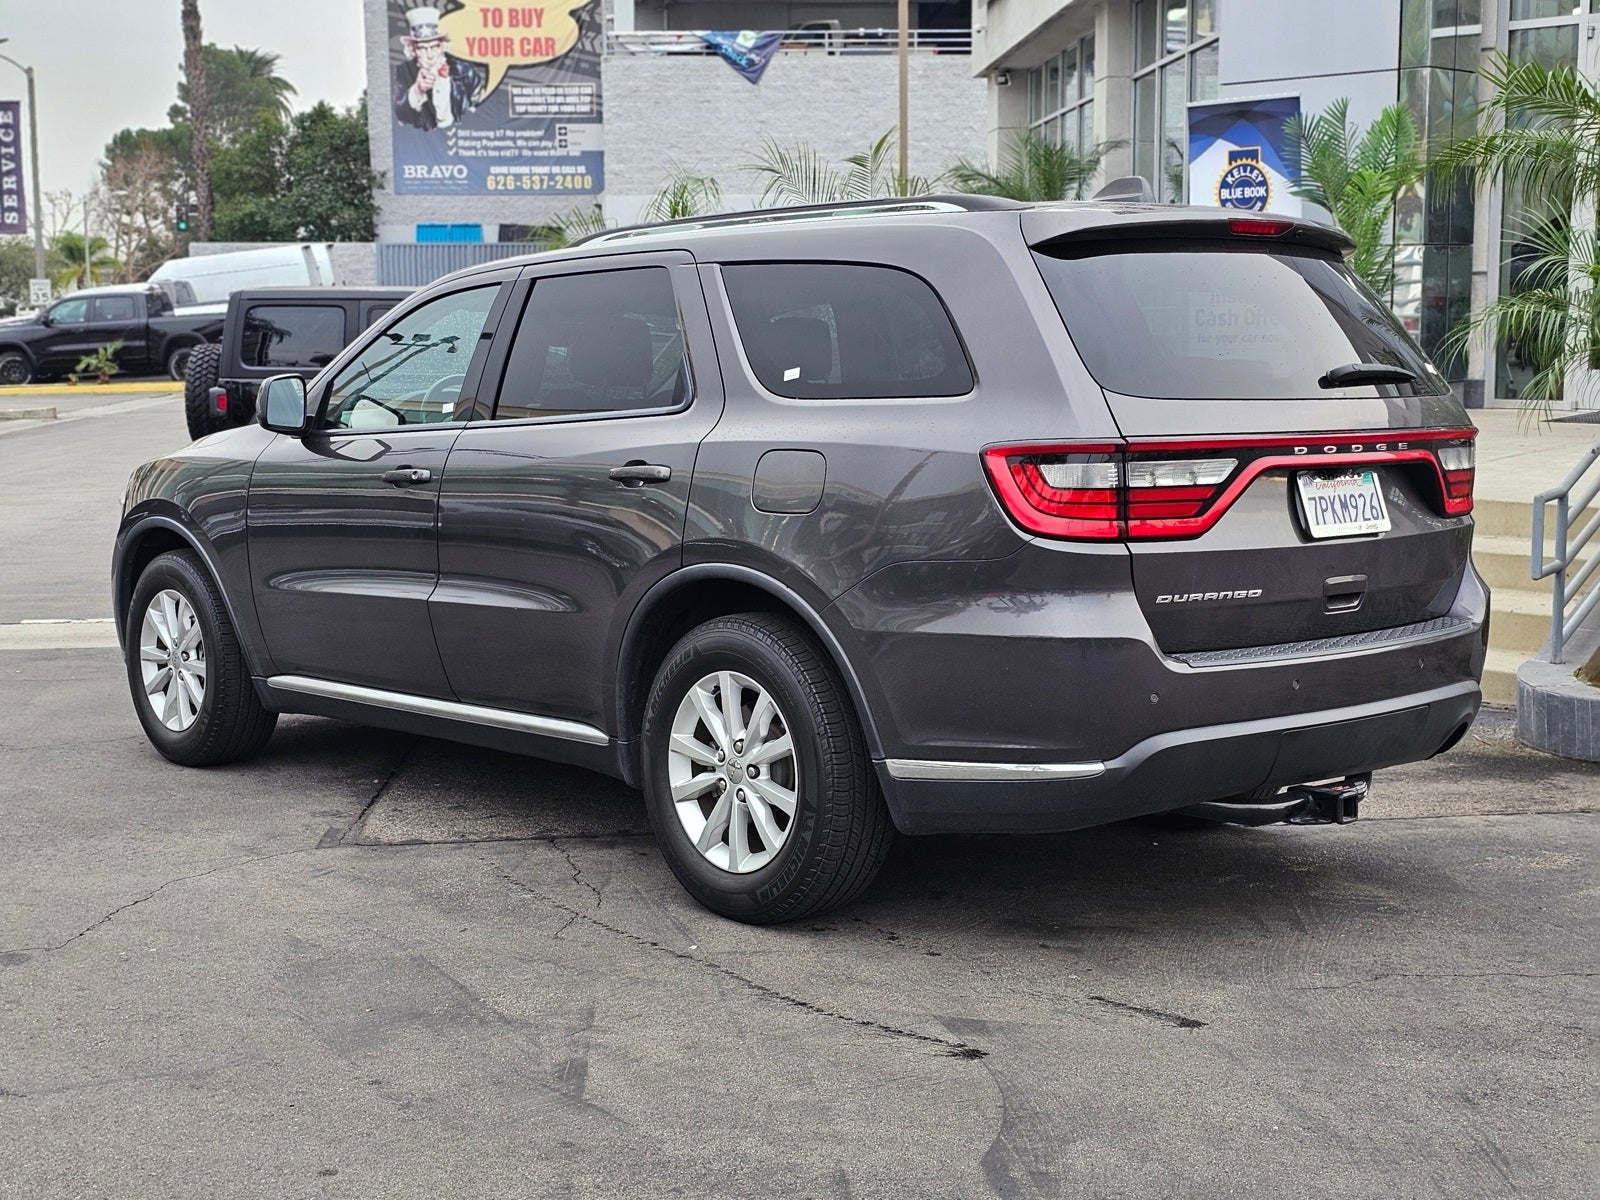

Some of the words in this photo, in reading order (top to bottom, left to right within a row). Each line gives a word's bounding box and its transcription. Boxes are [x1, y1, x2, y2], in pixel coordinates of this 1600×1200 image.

[480, 8, 505, 28] TO
[508, 8, 544, 28] BUY
[466, 36, 515, 58] YOUR
[519, 37, 556, 57] CAR
[0, 110, 18, 225] SERVICE
[403, 164, 468, 179] BRAVO
[1225, 166, 1264, 184] KELLEY
[486, 174, 592, 190] 626-537-2400
[1220, 187, 1244, 200] BLUE
[1244, 186, 1267, 198] BOOK
[32, 292, 50, 302] 35
[1195, 308, 1240, 327] Cash
[1294, 442, 1408, 455] DODGE
[1308, 492, 1381, 526] 7PKM926
[1156, 589, 1262, 604] DURANGO
